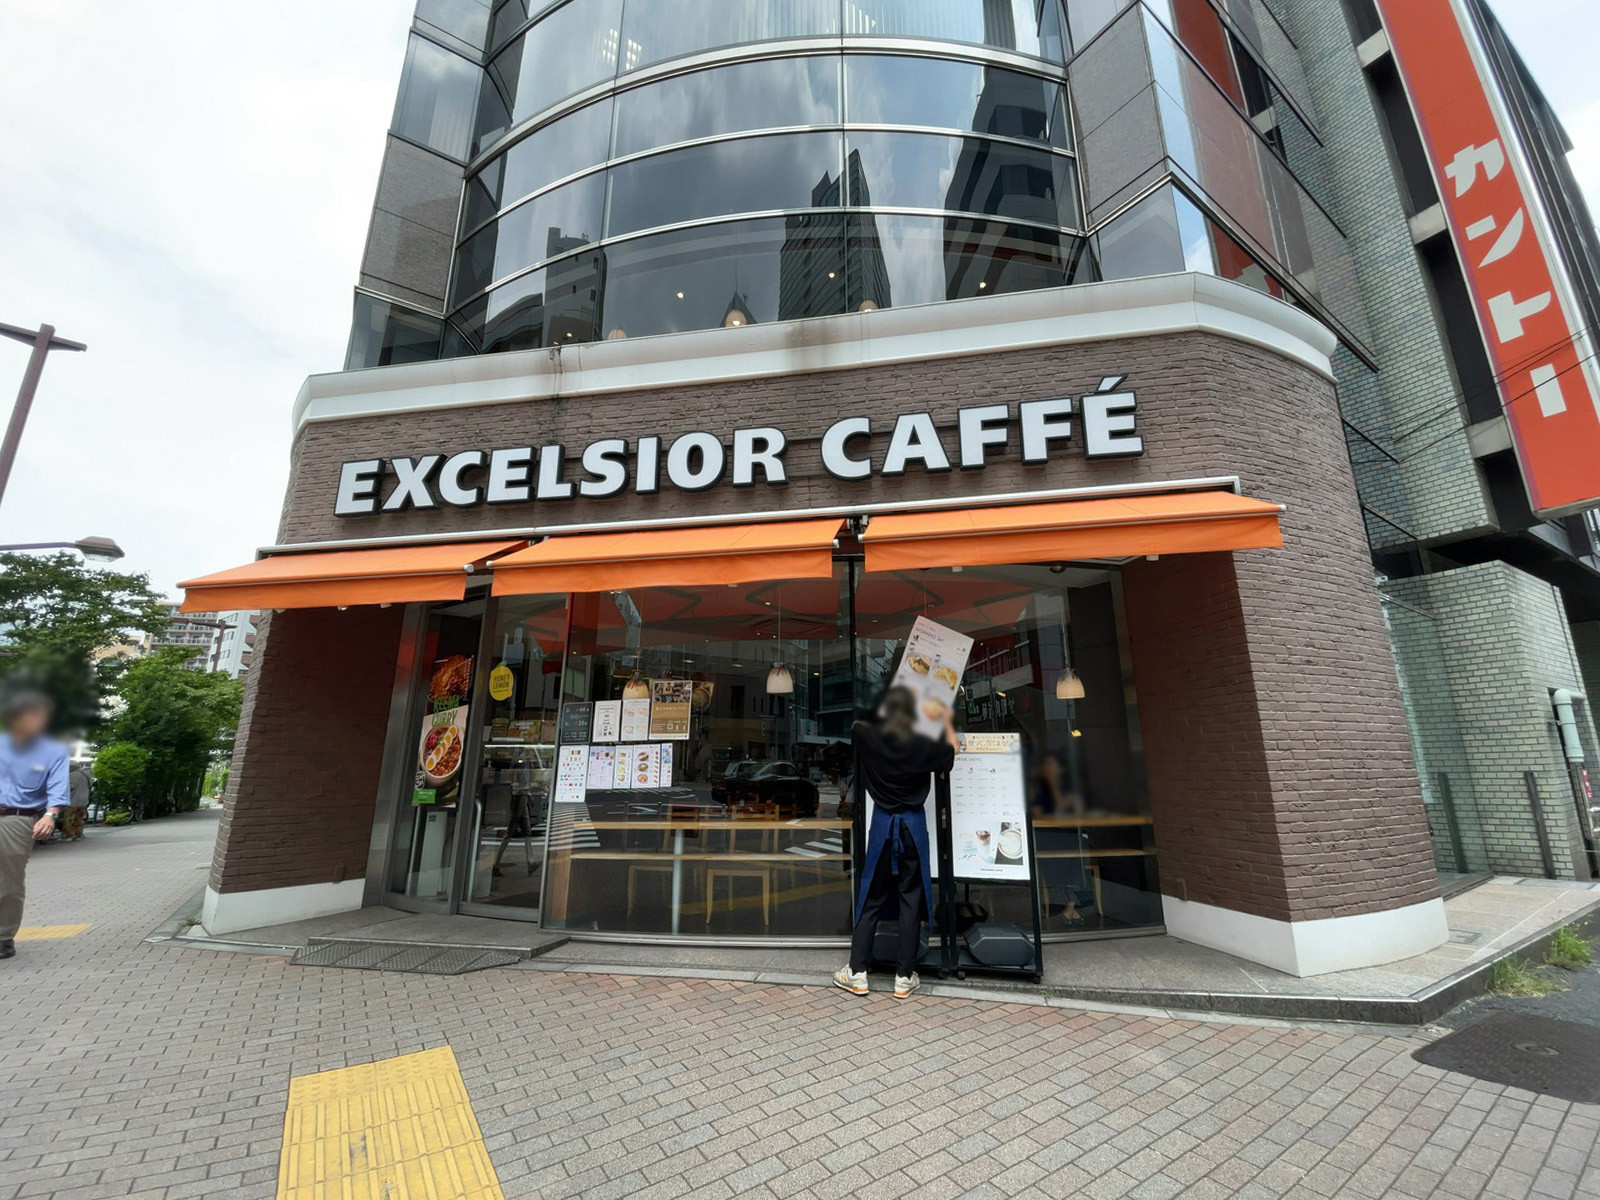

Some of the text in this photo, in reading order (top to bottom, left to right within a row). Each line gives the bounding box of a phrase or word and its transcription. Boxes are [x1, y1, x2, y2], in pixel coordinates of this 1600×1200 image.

[1443, 137, 1567, 418] カントー
[334, 375, 1144, 517] EXCELSIOR CAFFÉ
